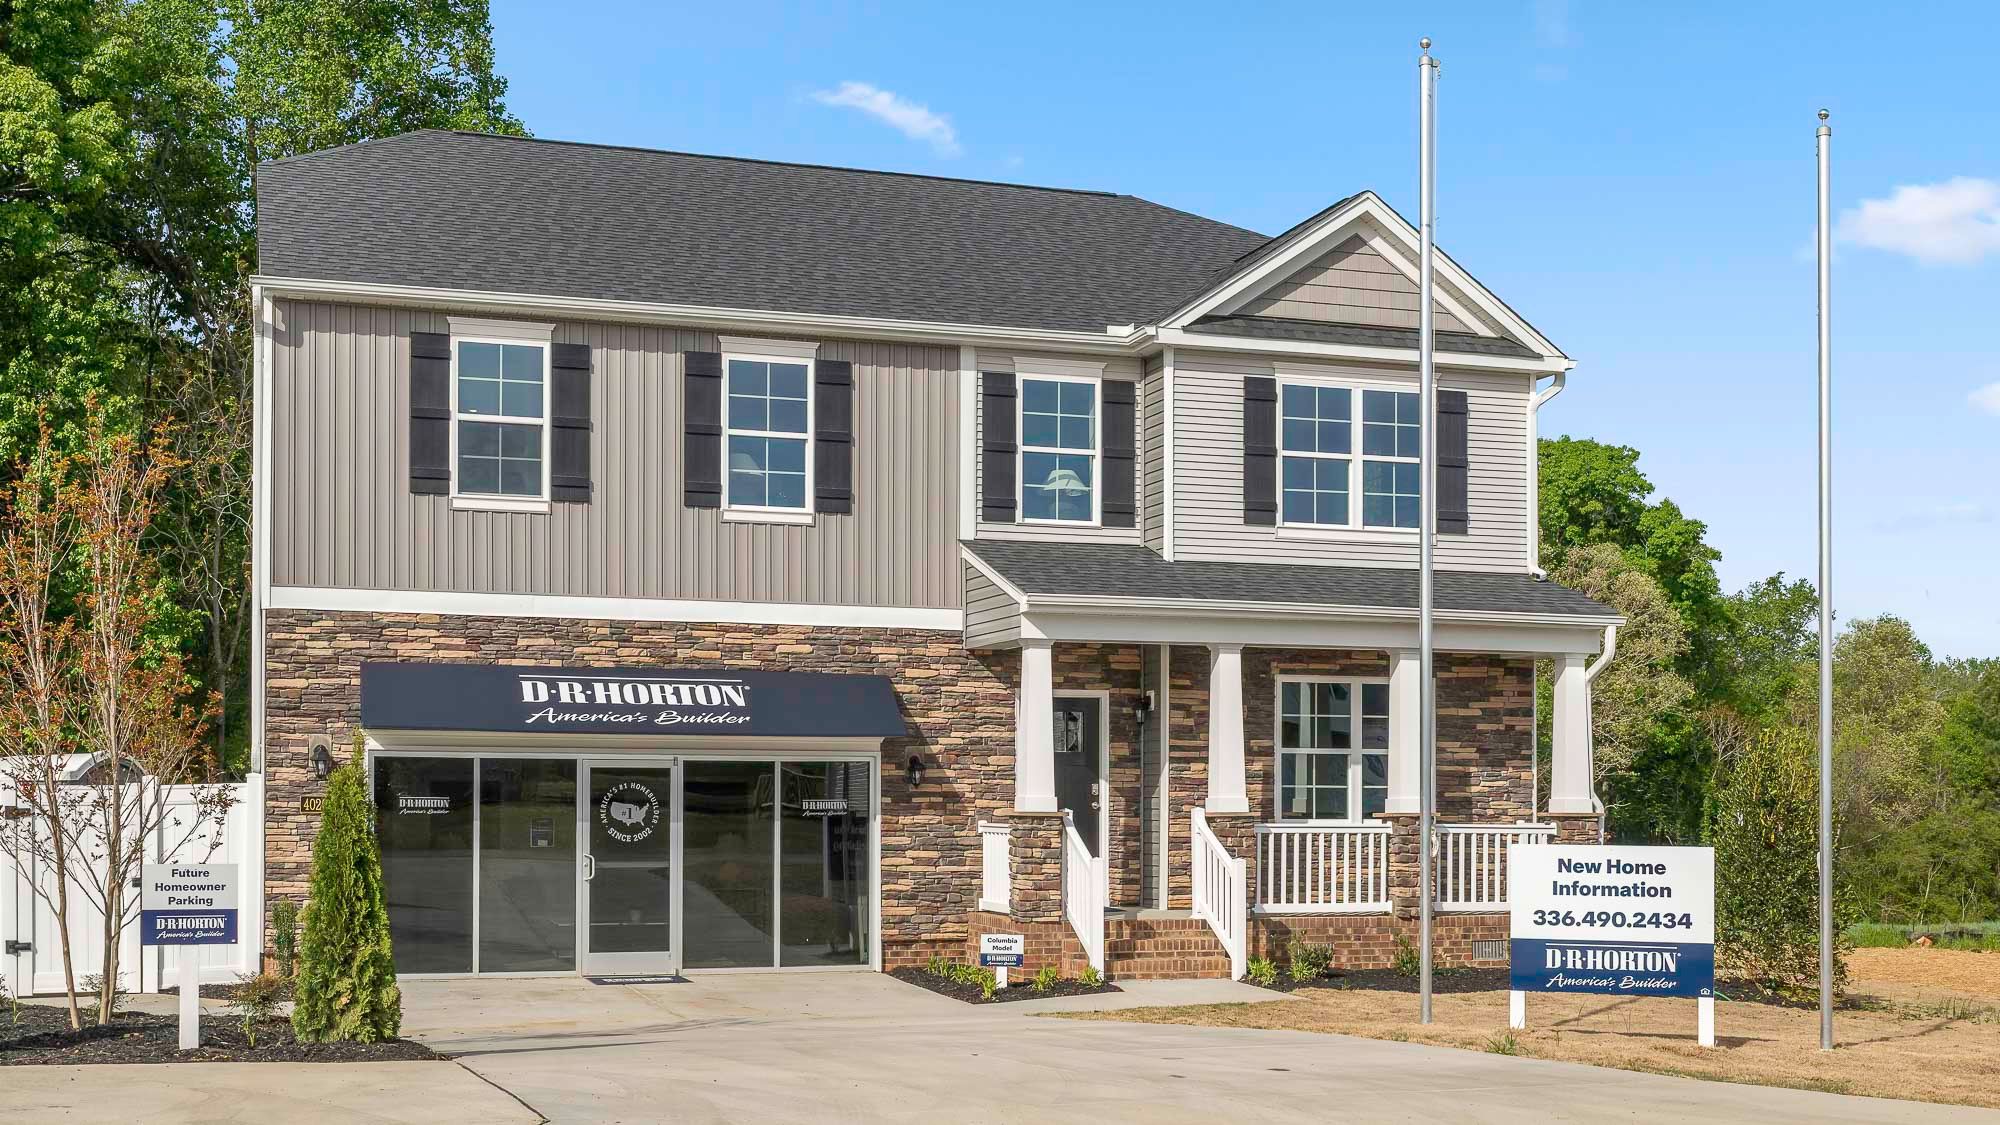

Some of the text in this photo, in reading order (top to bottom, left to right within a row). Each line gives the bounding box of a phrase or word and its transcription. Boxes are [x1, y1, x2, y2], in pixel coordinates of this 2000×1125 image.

[525, 707, 750, 725] America's Builder
[600, 786, 618, 824] AMERICA'S
[630, 781, 660, 824] HOMEBUILDER
[621, 807, 635, 820] #1
[607, 827, 652, 842] SINCE 2002
[171, 868, 210, 878] Future
[1557, 858, 1667, 875] New Home
[155, 882, 226, 892] Homeowner
[1552, 880, 1672, 898] Information
[168, 896, 213, 906] Parking
[1532, 909, 1693, 929] 336.490.2434
[1545, 973, 1677, 989] America's Builder
